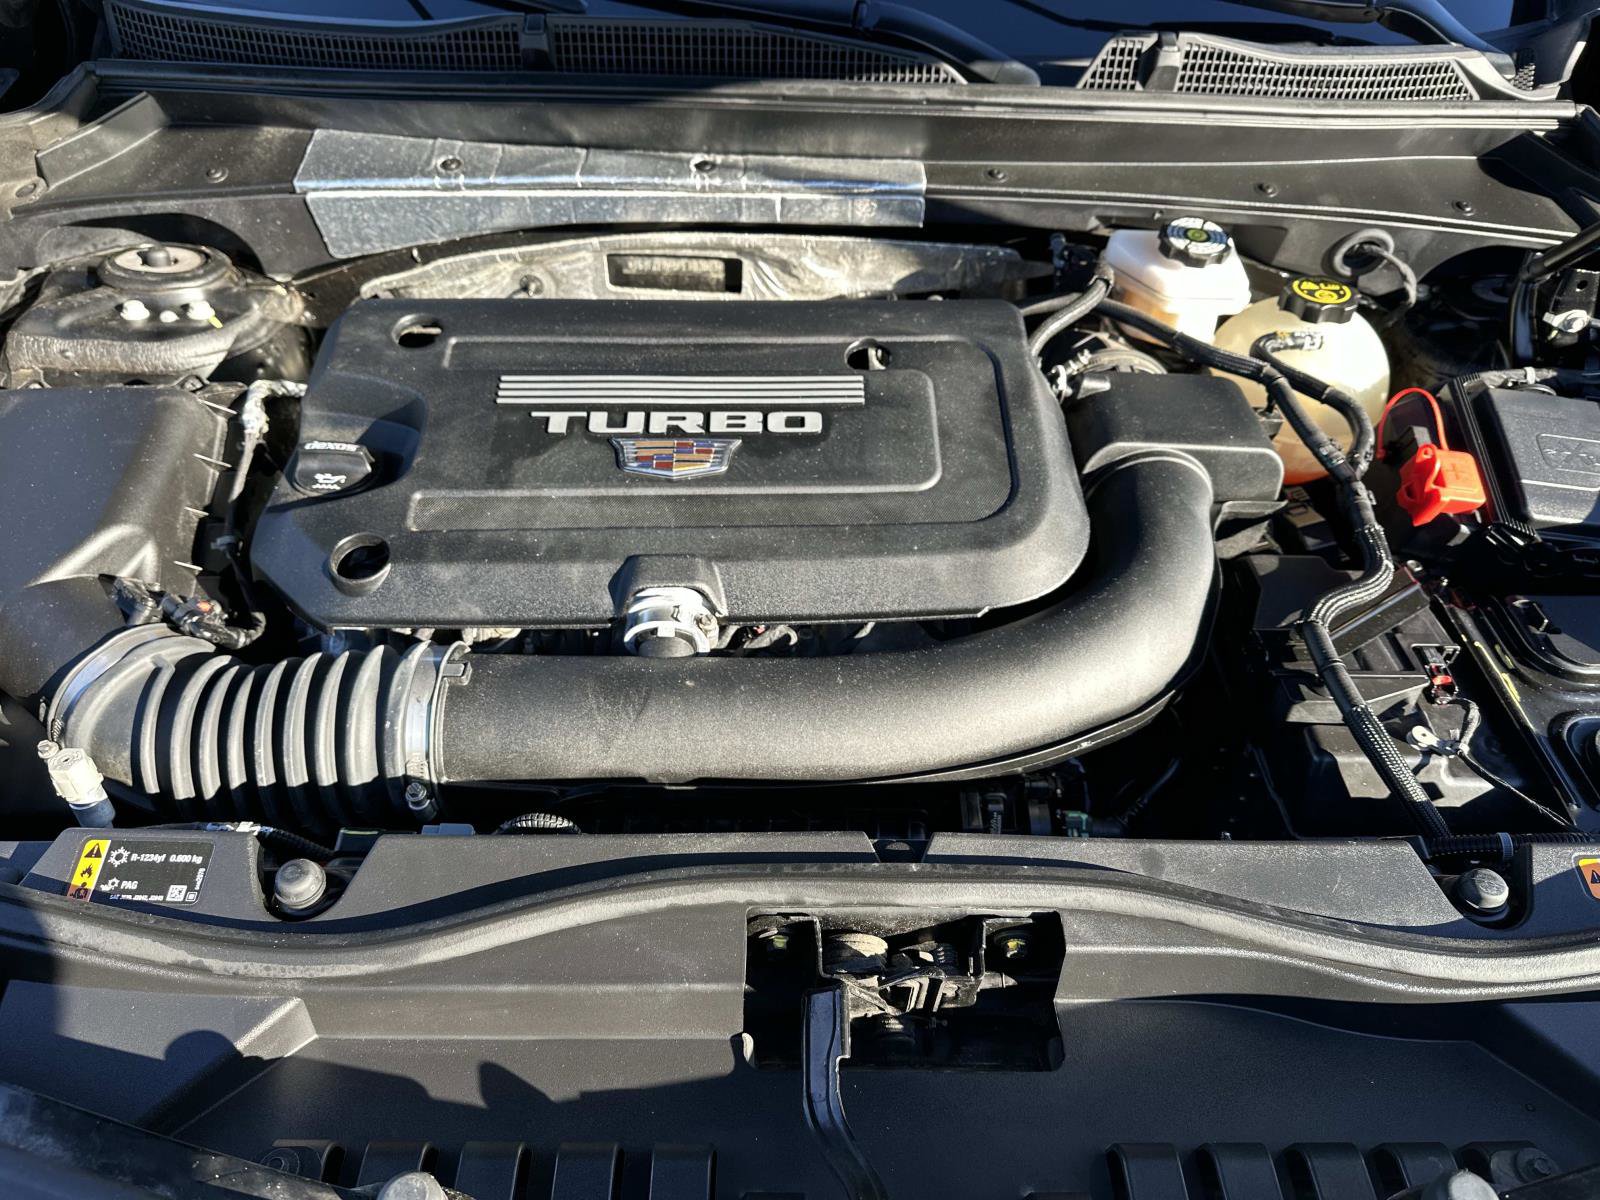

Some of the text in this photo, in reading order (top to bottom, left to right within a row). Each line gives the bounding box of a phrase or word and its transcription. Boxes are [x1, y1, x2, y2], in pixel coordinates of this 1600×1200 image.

[530, 411, 823, 434] TURBO
[191, 855, 203, 864] kg
[120, 880, 138, 889] PAG
